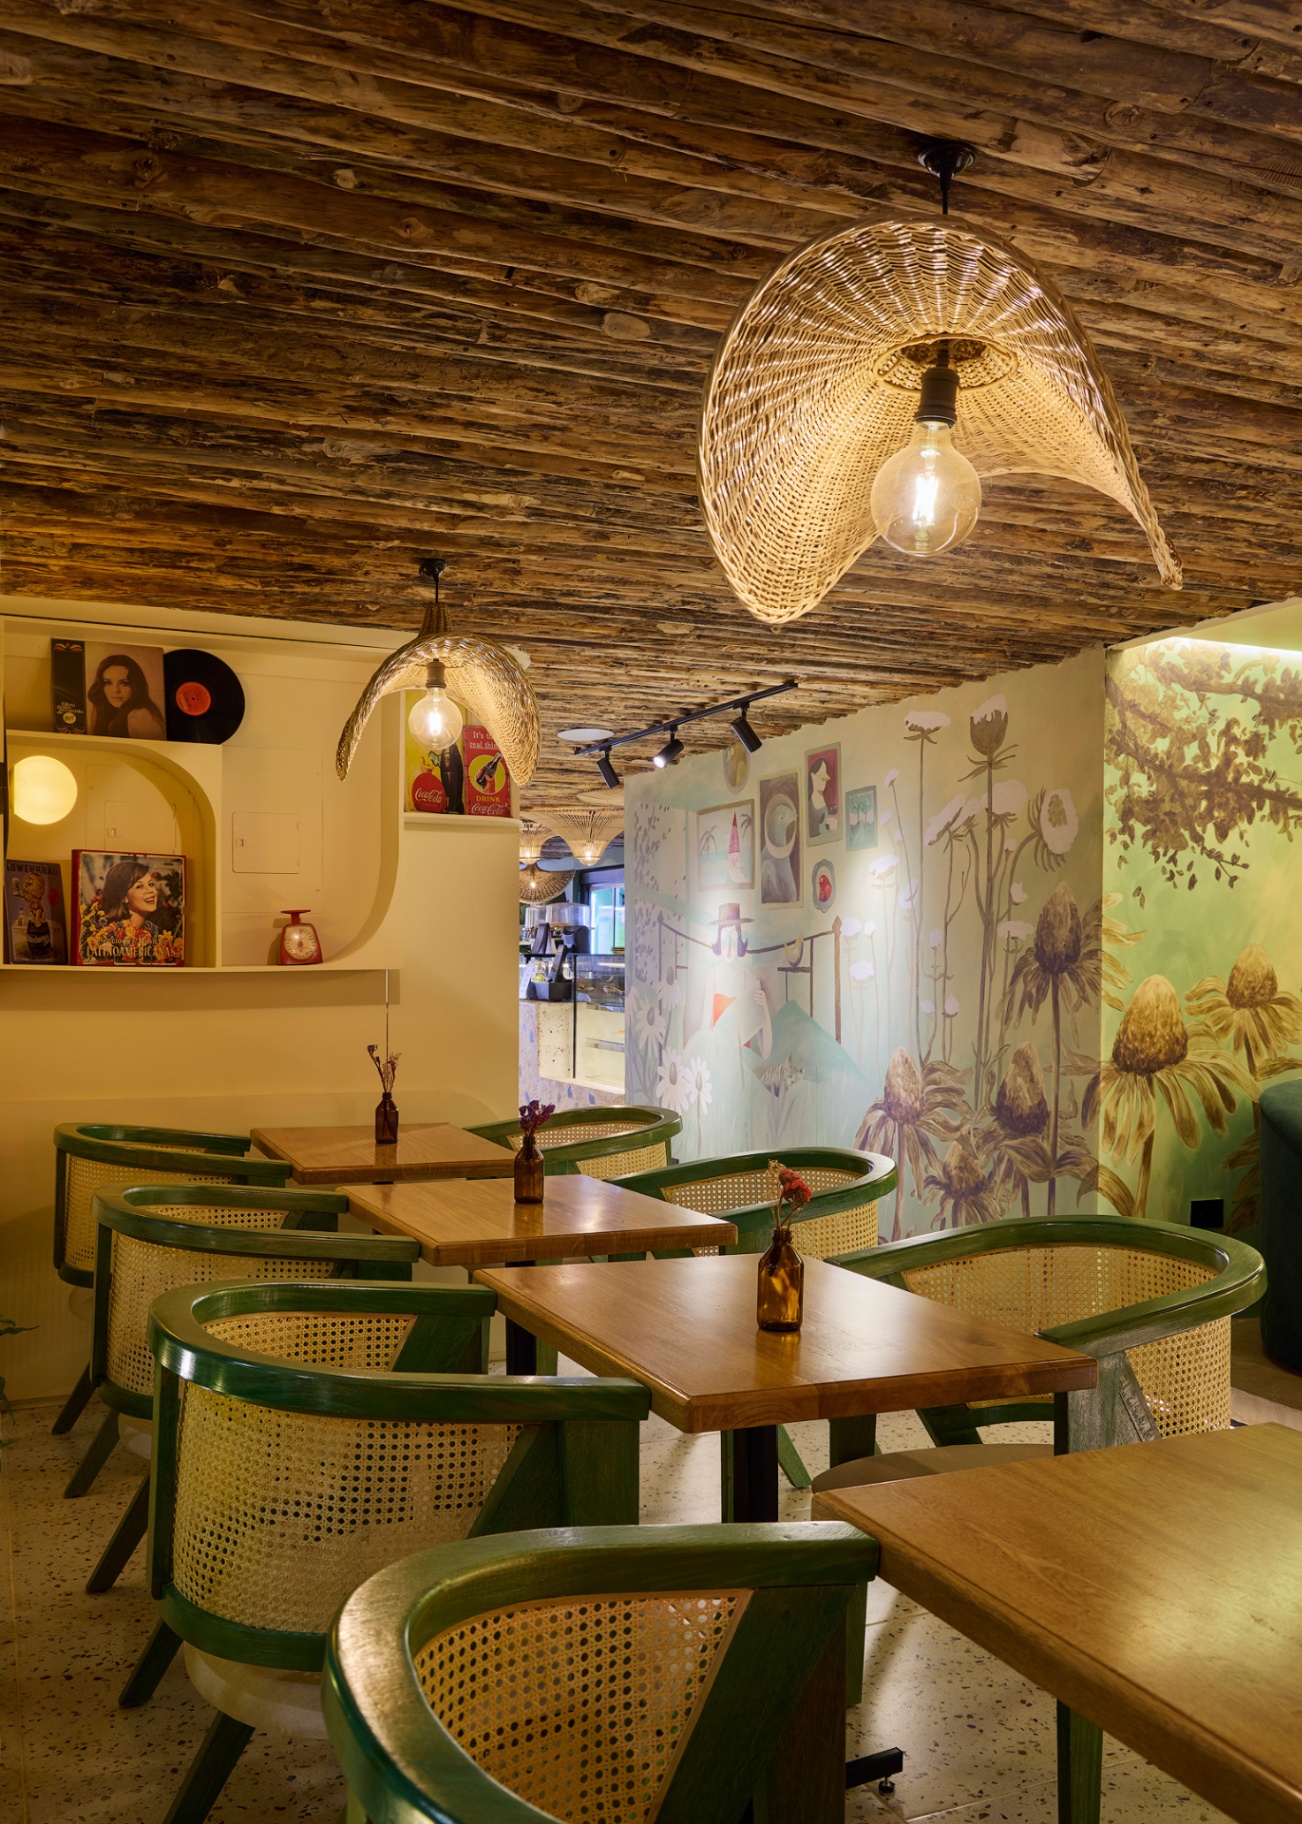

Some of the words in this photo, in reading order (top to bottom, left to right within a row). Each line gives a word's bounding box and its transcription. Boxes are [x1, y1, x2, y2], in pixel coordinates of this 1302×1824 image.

[473, 731, 484, 739] It's
[469, 741, 482, 749] real
[484, 742, 498, 750] thin
